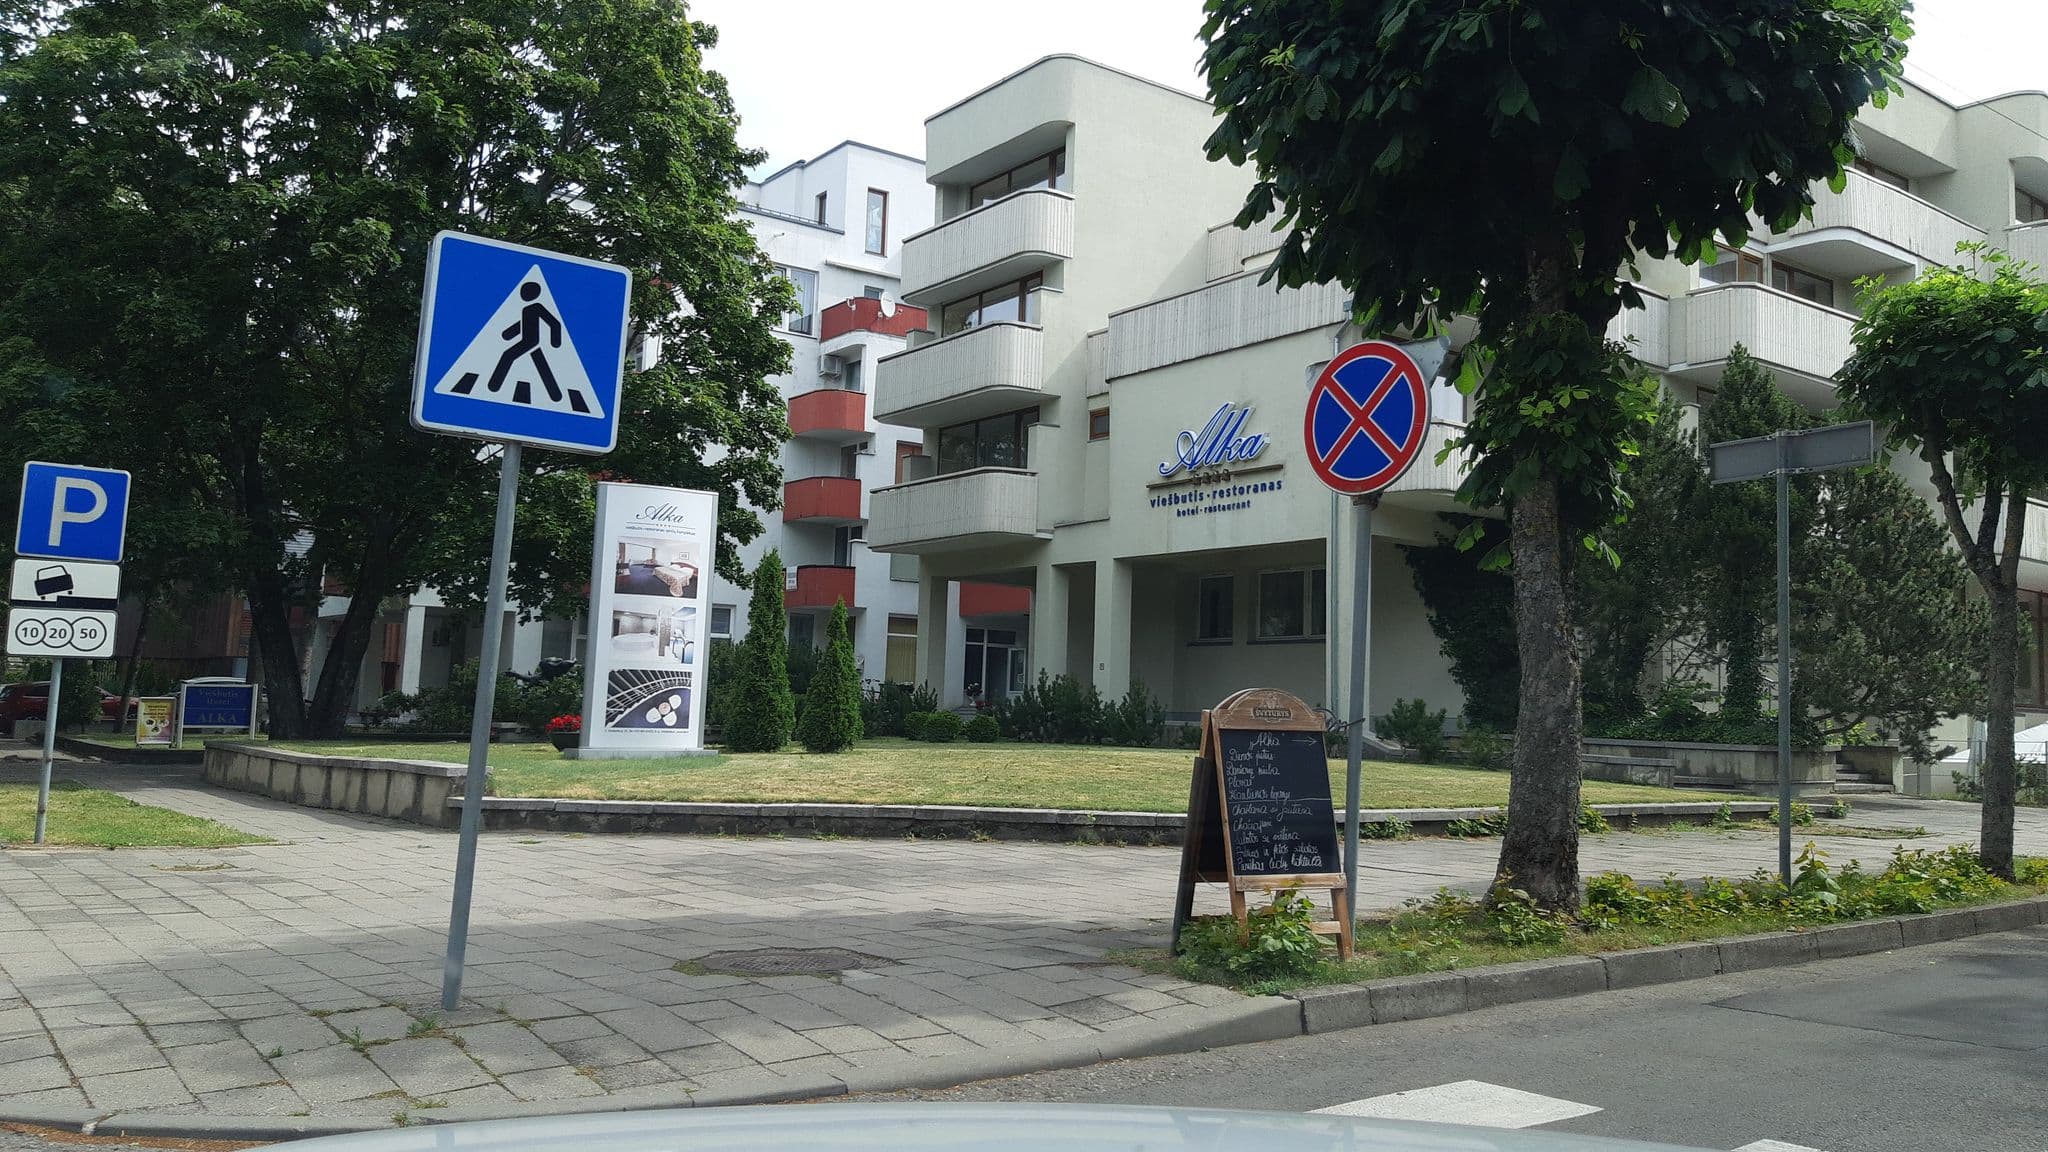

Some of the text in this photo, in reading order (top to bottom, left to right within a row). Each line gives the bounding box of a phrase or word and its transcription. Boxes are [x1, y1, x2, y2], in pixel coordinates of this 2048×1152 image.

[1159, 402, 1268, 476] Alka
[1150, 480, 1282, 508] viešbutis restoranas
[48, 476, 108, 547] P
[635, 503, 684, 523] Alka
[1177, 500, 1251, 517] hotel restaurant
[22, 627, 98, 640] 10 20 50
[200, 713, 237, 723] ALKA
